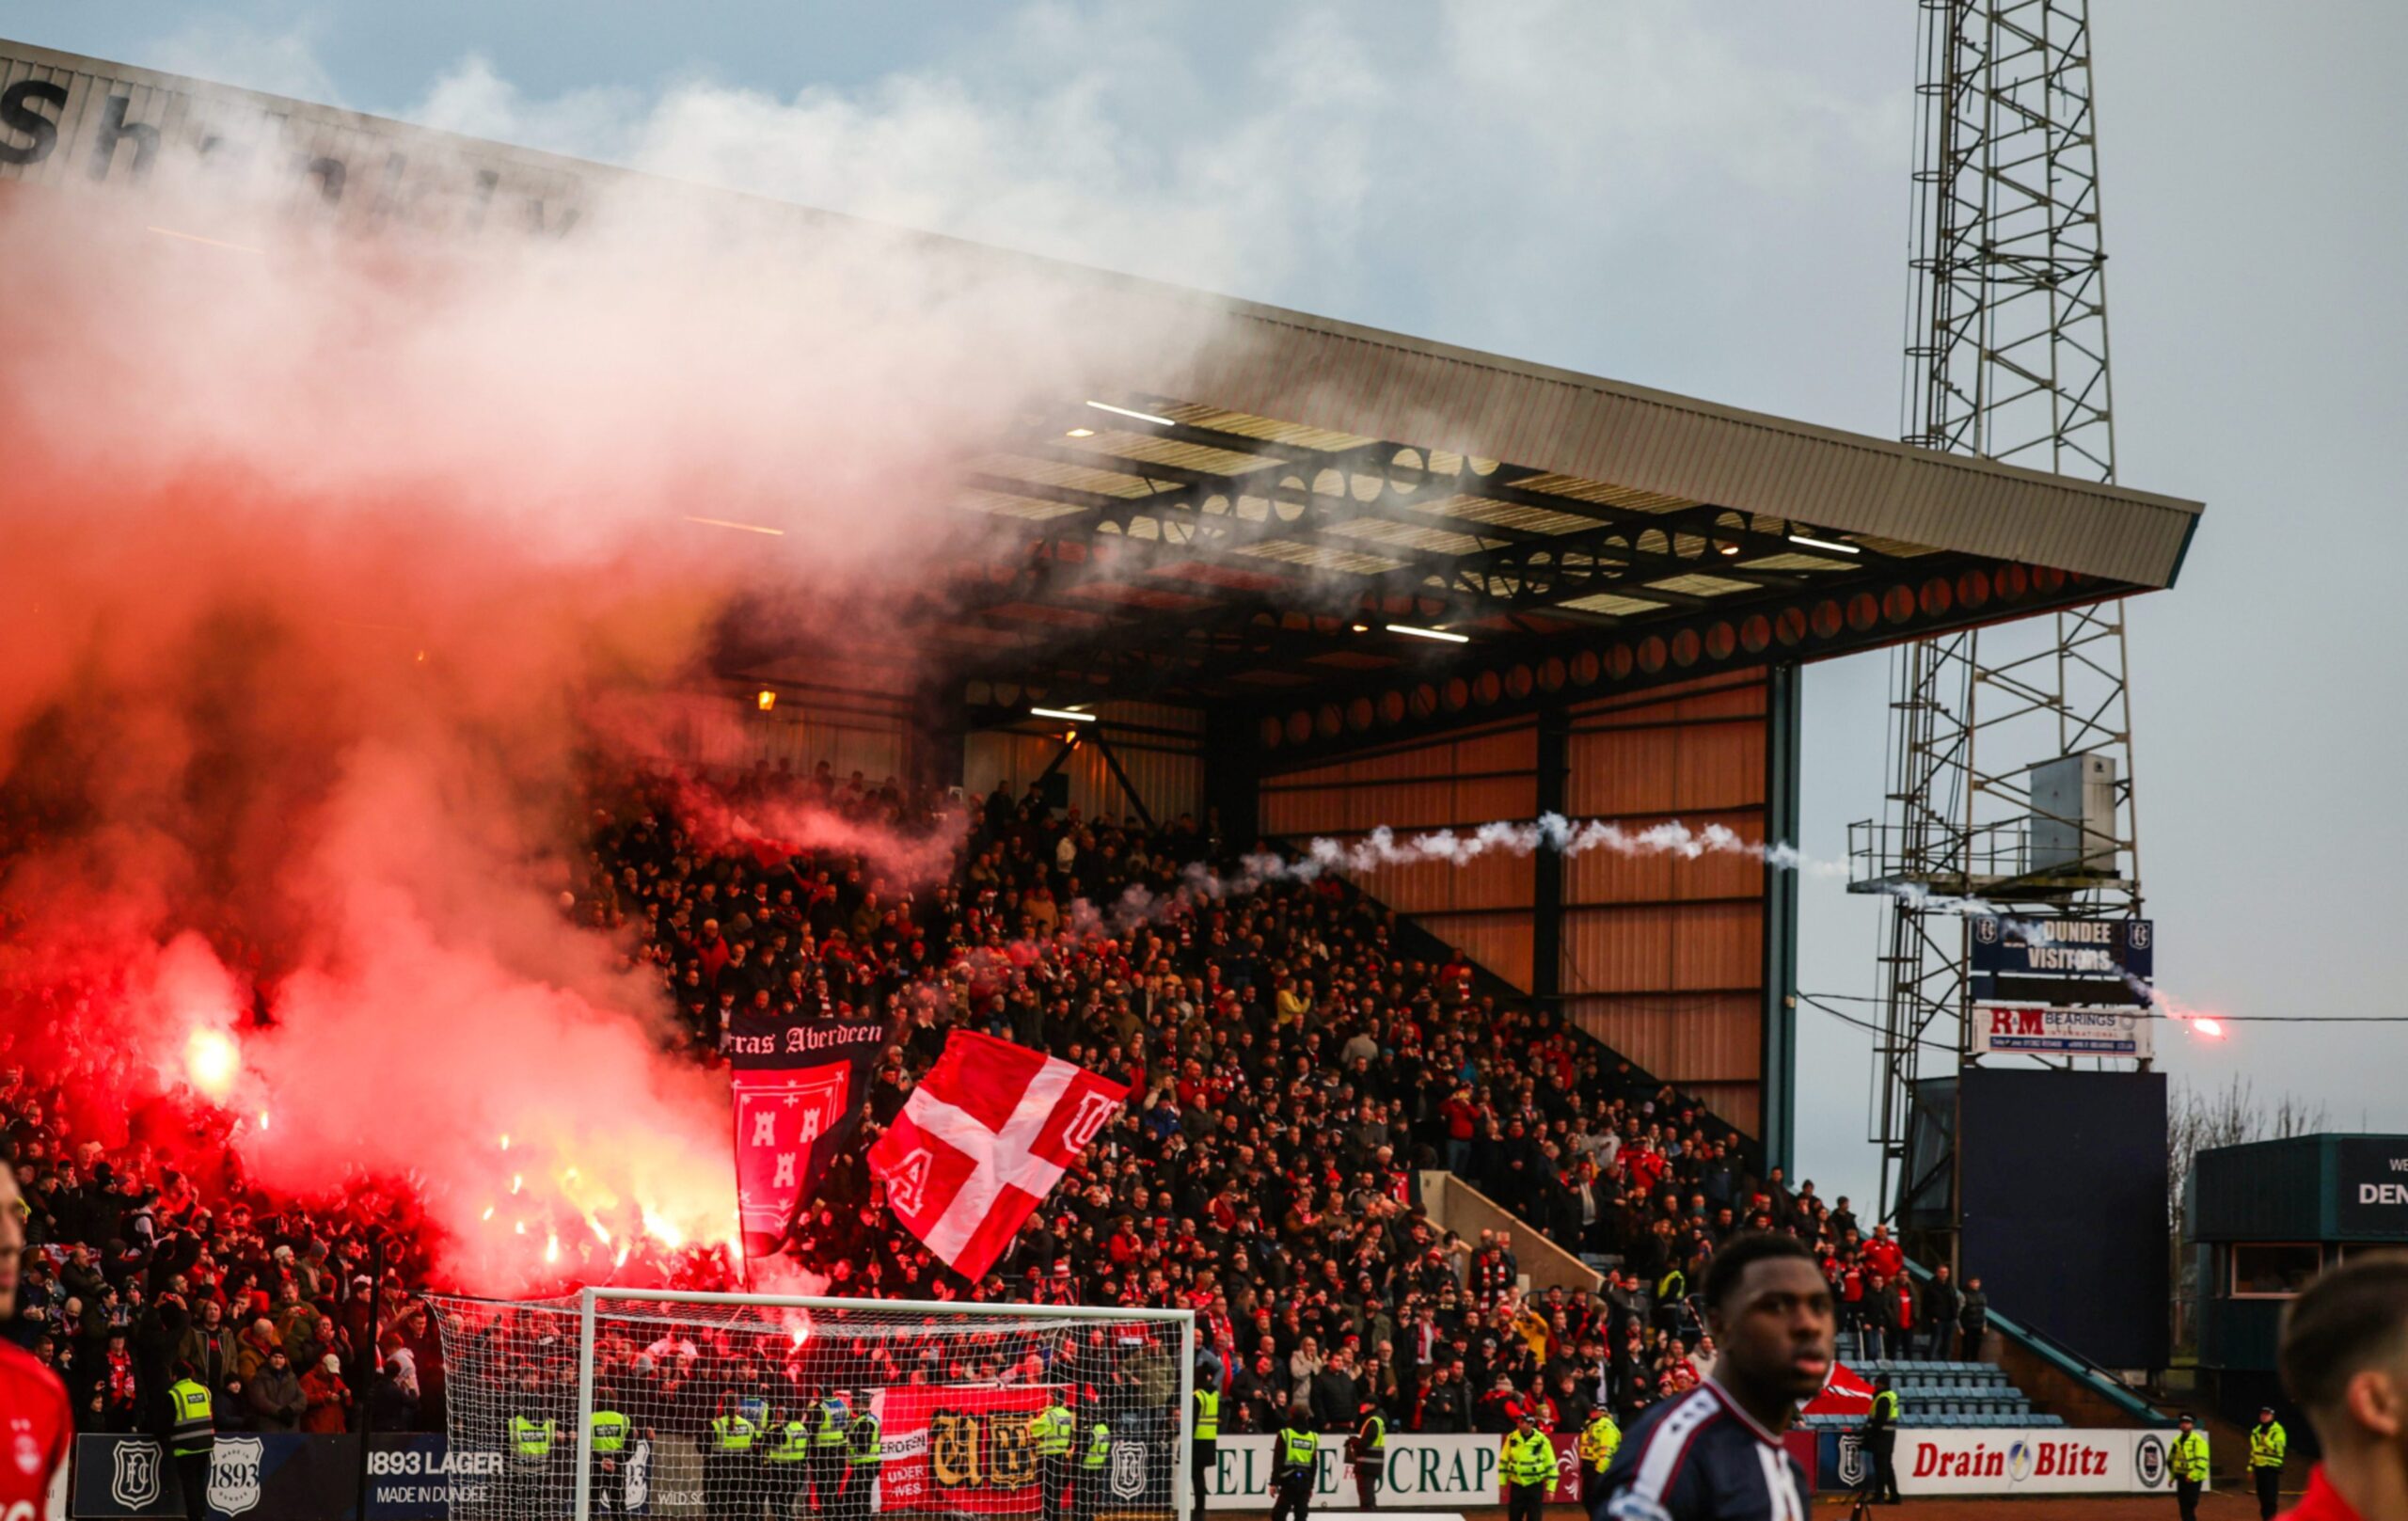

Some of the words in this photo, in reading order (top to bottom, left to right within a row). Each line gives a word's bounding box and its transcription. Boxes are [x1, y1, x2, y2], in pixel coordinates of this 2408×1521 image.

[2044, 920, 2111, 943] DUNDEE
[2028, 946, 2111, 972] VISITORS
[1989, 1007, 2045, 1036] R&M
[2045, 1011, 2115, 1027] BEARINGS
[786, 1023, 883, 1054] Aberdeen
[367, 1451, 421, 1475] 1893
[425, 1451, 504, 1475] LAGER
[1912, 1442, 2004, 1478] Drain
[2034, 1442, 2109, 1477] Blitz
[210, 1463, 259, 1489] 1893
[376, 1486, 417, 1503] MADE
[418, 1486, 431, 1502] IN
[432, 1486, 489, 1502] DUNDEE
